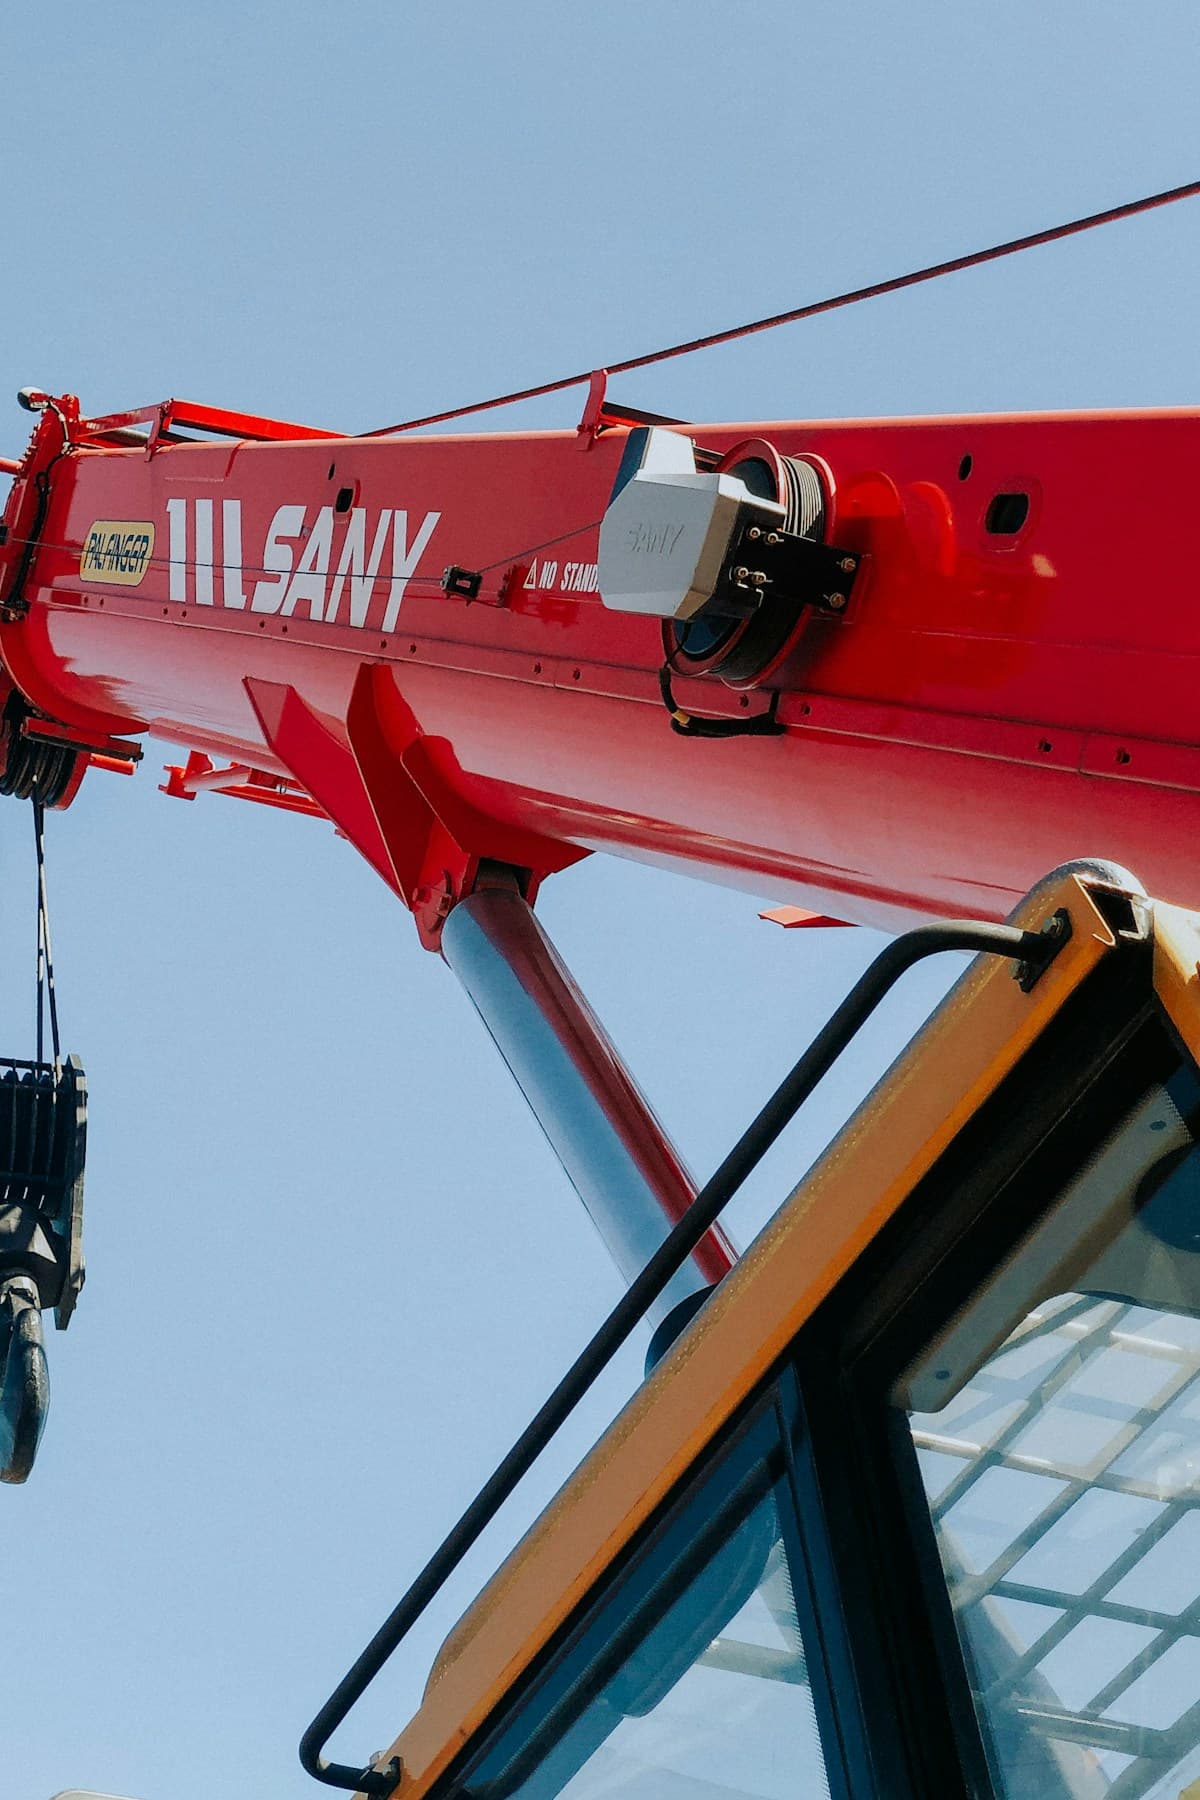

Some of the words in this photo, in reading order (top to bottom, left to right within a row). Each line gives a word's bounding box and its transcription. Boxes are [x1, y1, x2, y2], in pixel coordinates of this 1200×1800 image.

[83, 532, 149, 574] PALFINGER
[625, 523, 686, 555] SANY
[251, 505, 442, 633] SANY
[539, 560, 558, 590] NO
